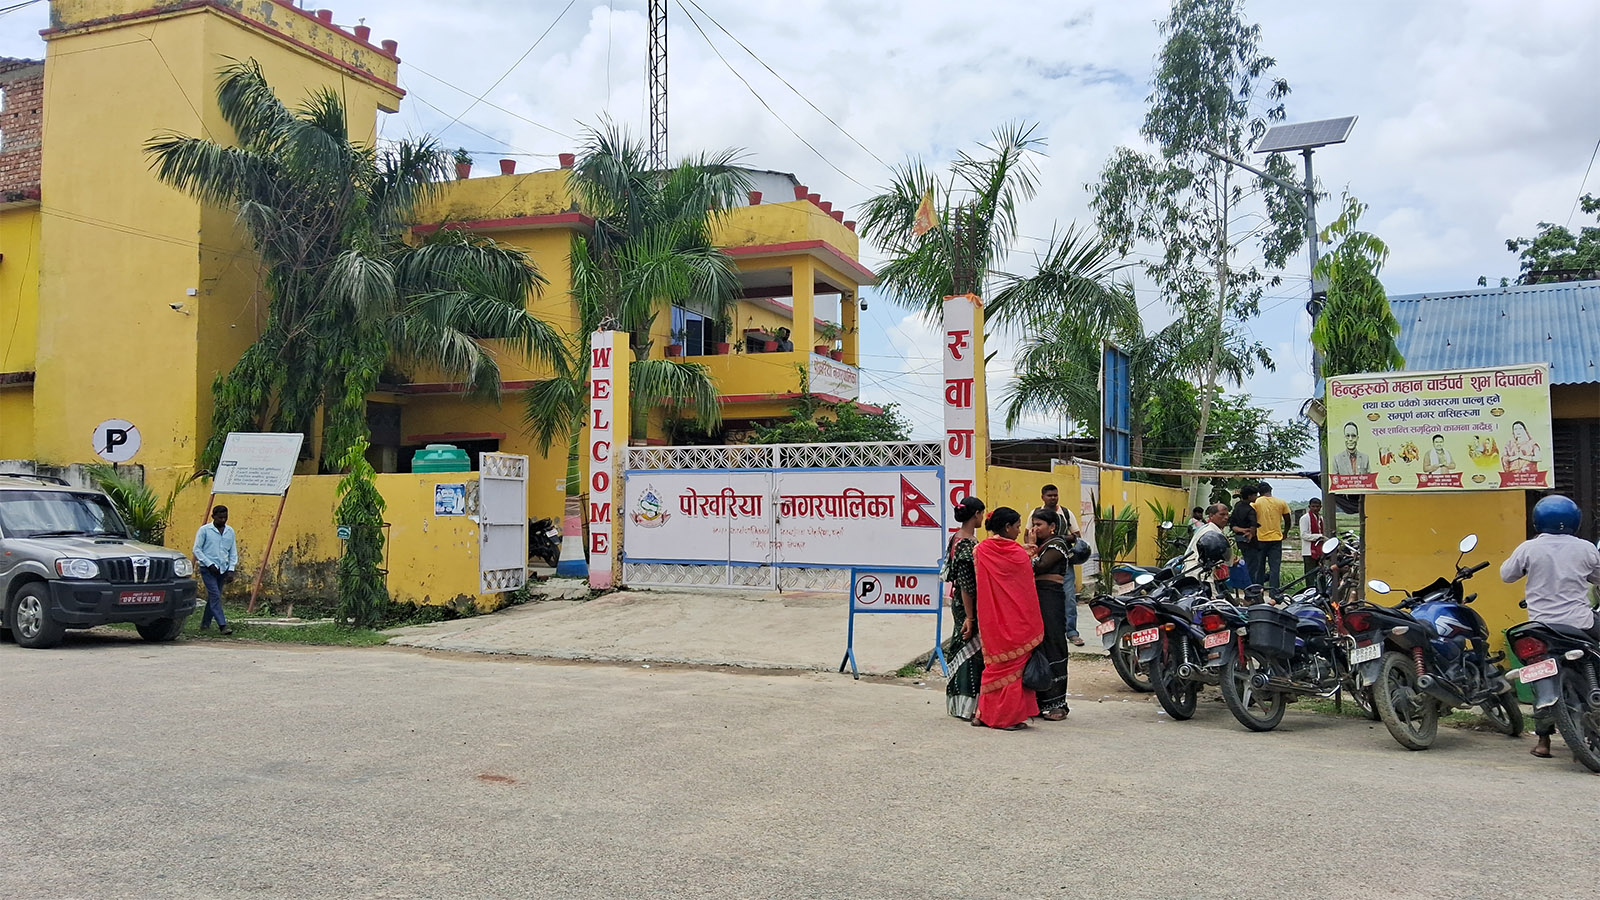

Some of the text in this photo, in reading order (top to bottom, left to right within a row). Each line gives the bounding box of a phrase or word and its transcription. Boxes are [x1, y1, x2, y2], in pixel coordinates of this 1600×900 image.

[1392, 379, 1423, 394] महान
[1470, 376, 1491, 392] शुभ
[1494, 369, 1543, 387] दिपावली
[1362, 401, 1378, 411] तथा
[1380, 400, 1396, 409] छठ
[1423, 397, 1460, 407] अवसरमा
[1486, 394, 1501, 405] हुने
[1387, 411, 1414, 422] सम्पूर्ण
[1415, 410, 1435, 419] नगर
[945, 329, 975, 535] स्वागत
[1443, 423, 1470, 433] कामना
[106, 429, 128, 453] P
[590, 347, 612, 555] WELCOME
[678, 487, 763, 518] पोखरिया
[780, 487, 896, 519] नगरपालिका
[861, 581, 876, 597] P
[895, 575, 918, 589] NO
[883, 593, 931, 606] PARKING
